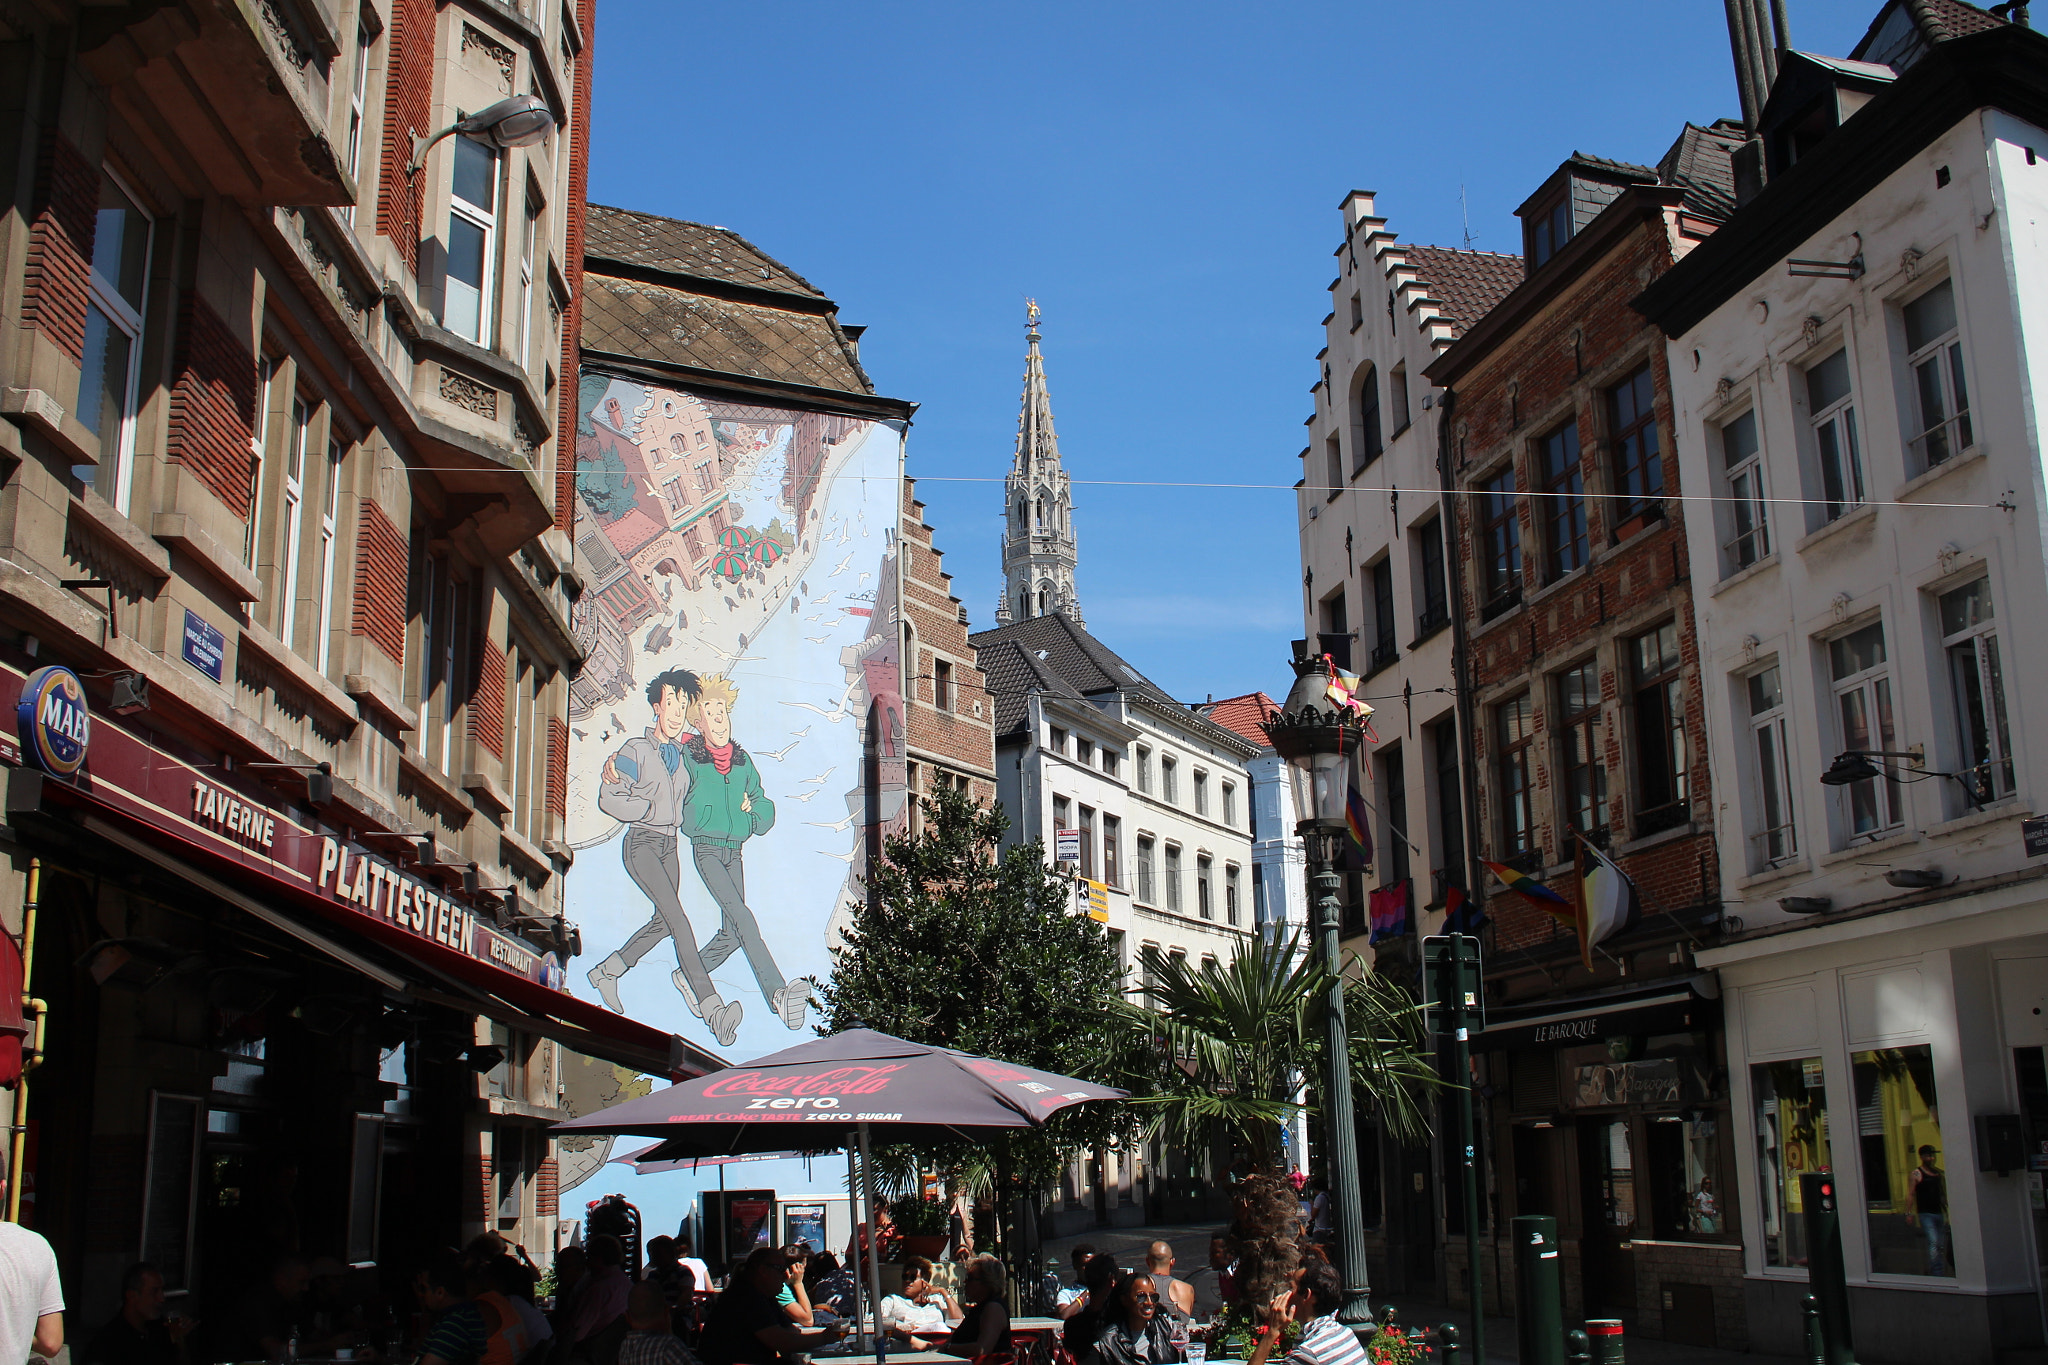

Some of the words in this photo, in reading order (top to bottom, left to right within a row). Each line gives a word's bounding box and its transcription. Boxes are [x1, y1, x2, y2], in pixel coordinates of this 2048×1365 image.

[634, 539, 673, 568] PLATTESTEEN
[39, 692, 90, 748] MAES
[193, 780, 275, 848] TAVERNE
[317, 836, 474, 956] PLATTESTEEN
[489, 937, 533, 975] RESTAURANT
[1535, 1026, 1548, 1042] LE
[1548, 1018, 1598, 1040] BAROQUE
[668, 1114, 713, 1122] GREAT
[713, 1112, 760, 1122] Coke
[760, 1113, 802, 1121] TASTE
[805, 1112, 853, 1121] zero
[855, 1113, 903, 1121] SUGAR
